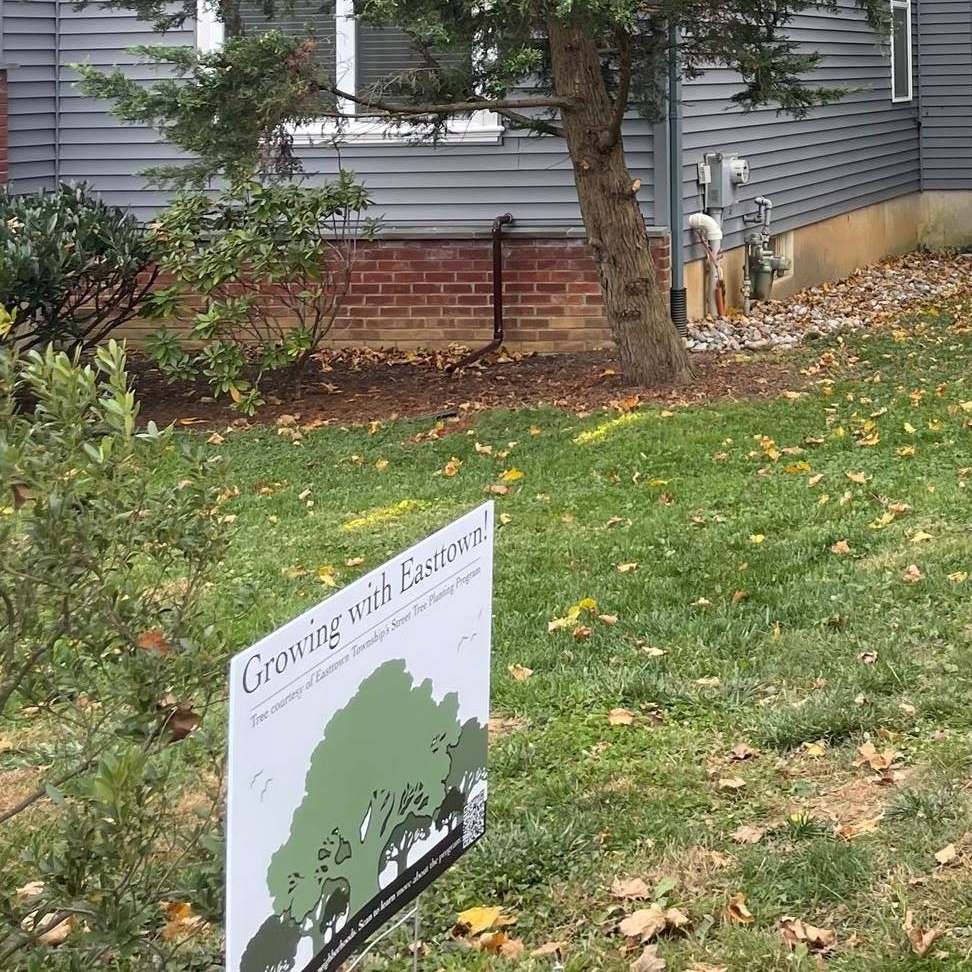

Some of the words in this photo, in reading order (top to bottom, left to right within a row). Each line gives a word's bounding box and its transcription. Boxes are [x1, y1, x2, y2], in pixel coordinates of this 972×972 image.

[242, 613, 342, 694] Growing
[348, 572, 392, 626] with
[400, 510, 488, 594] Easttown!
[250, 710, 269, 728] Tree
[270, 685, 304, 715] courtesy
[305, 673, 316, 689] of
[315, 654, 350, 683] Easttown
[351, 624, 390, 657] Township's
[391, 611, 411, 631] Street
[413, 602, 427, 616] Tree
[429, 584, 454, 607] Planting
[456, 567, 481, 588] Program
[380, 894, 396, 910] learn
